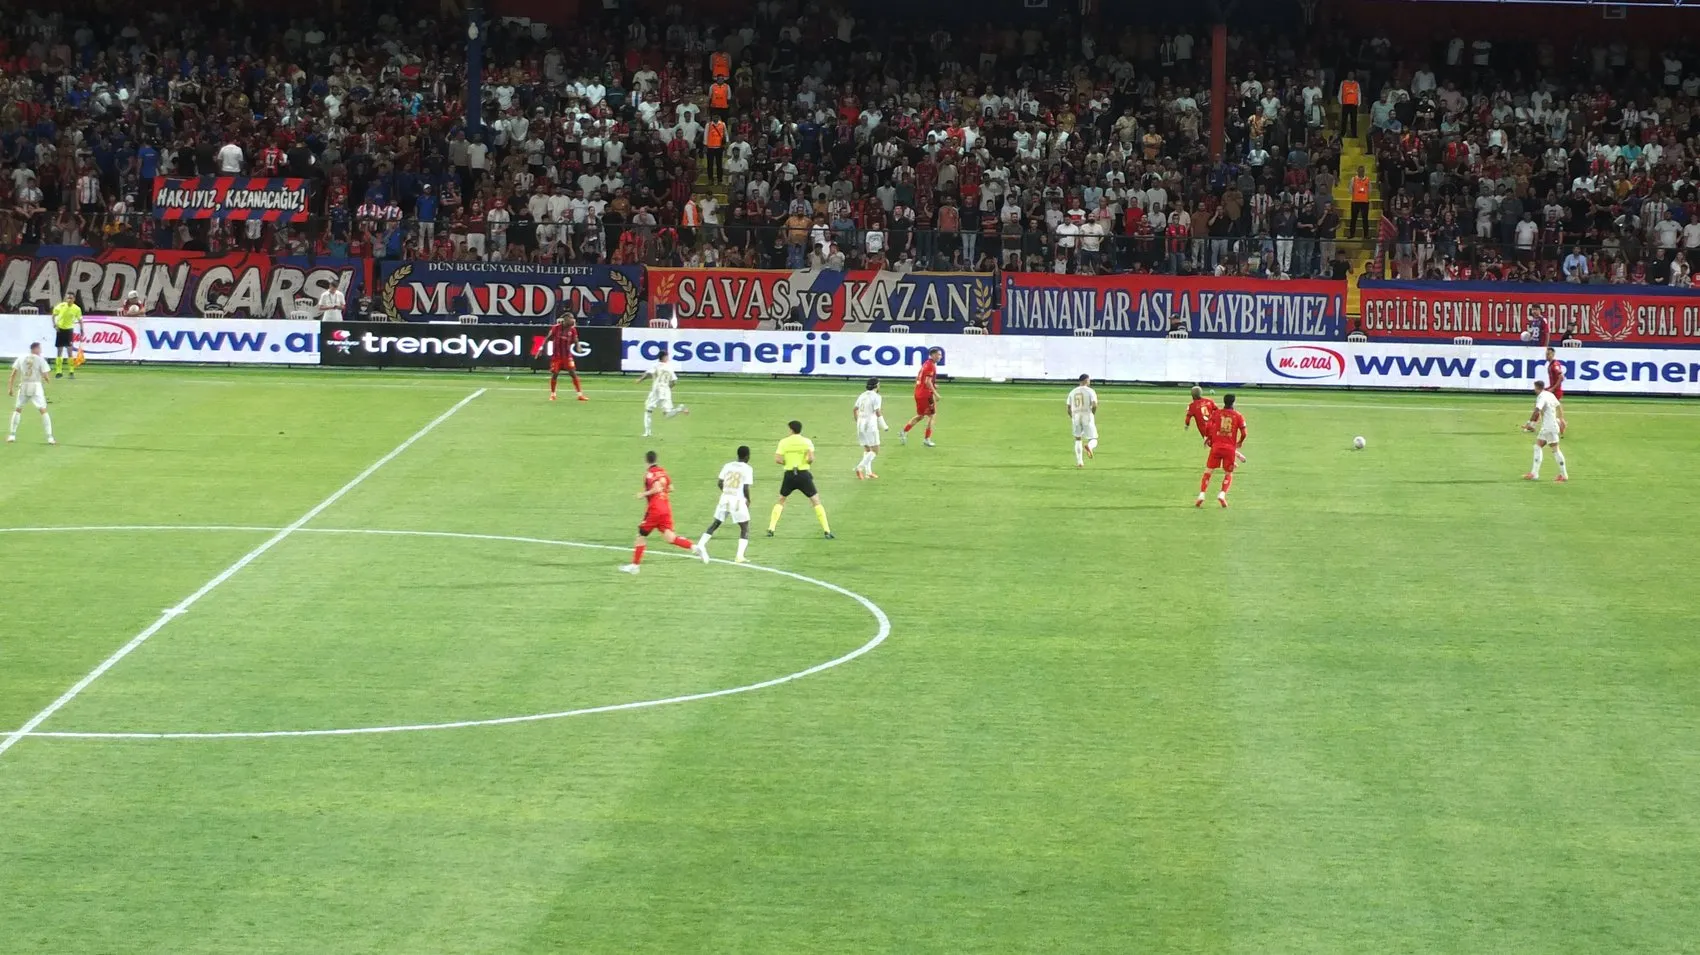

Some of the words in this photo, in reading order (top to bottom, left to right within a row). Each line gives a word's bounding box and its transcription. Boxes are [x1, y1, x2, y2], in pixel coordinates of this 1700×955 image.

[225, 186, 305, 212] KAZANACAĞIZ!
[429, 262, 454, 271] DÜN
[457, 262, 497, 272] BUGÜN
[500, 264, 534, 273] YARIN
[678, 278, 790, 329] SAVAŞ
[799, 292, 832, 320] ve
[843, 281, 972, 322] KAZAN
[1007, 279, 1130, 332] İNANANLAR
[1366, 296, 1428, 334] GEÇİLİR
[1433, 298, 1481, 332] SENİN
[1488, 299, 1522, 336] İÇİN
[1638, 305, 1677, 335] SUAL
[362, 332, 521, 358] trendyol
[1279, 356, 1332, 371] m.aras
[724, 471, 742, 489] 28
